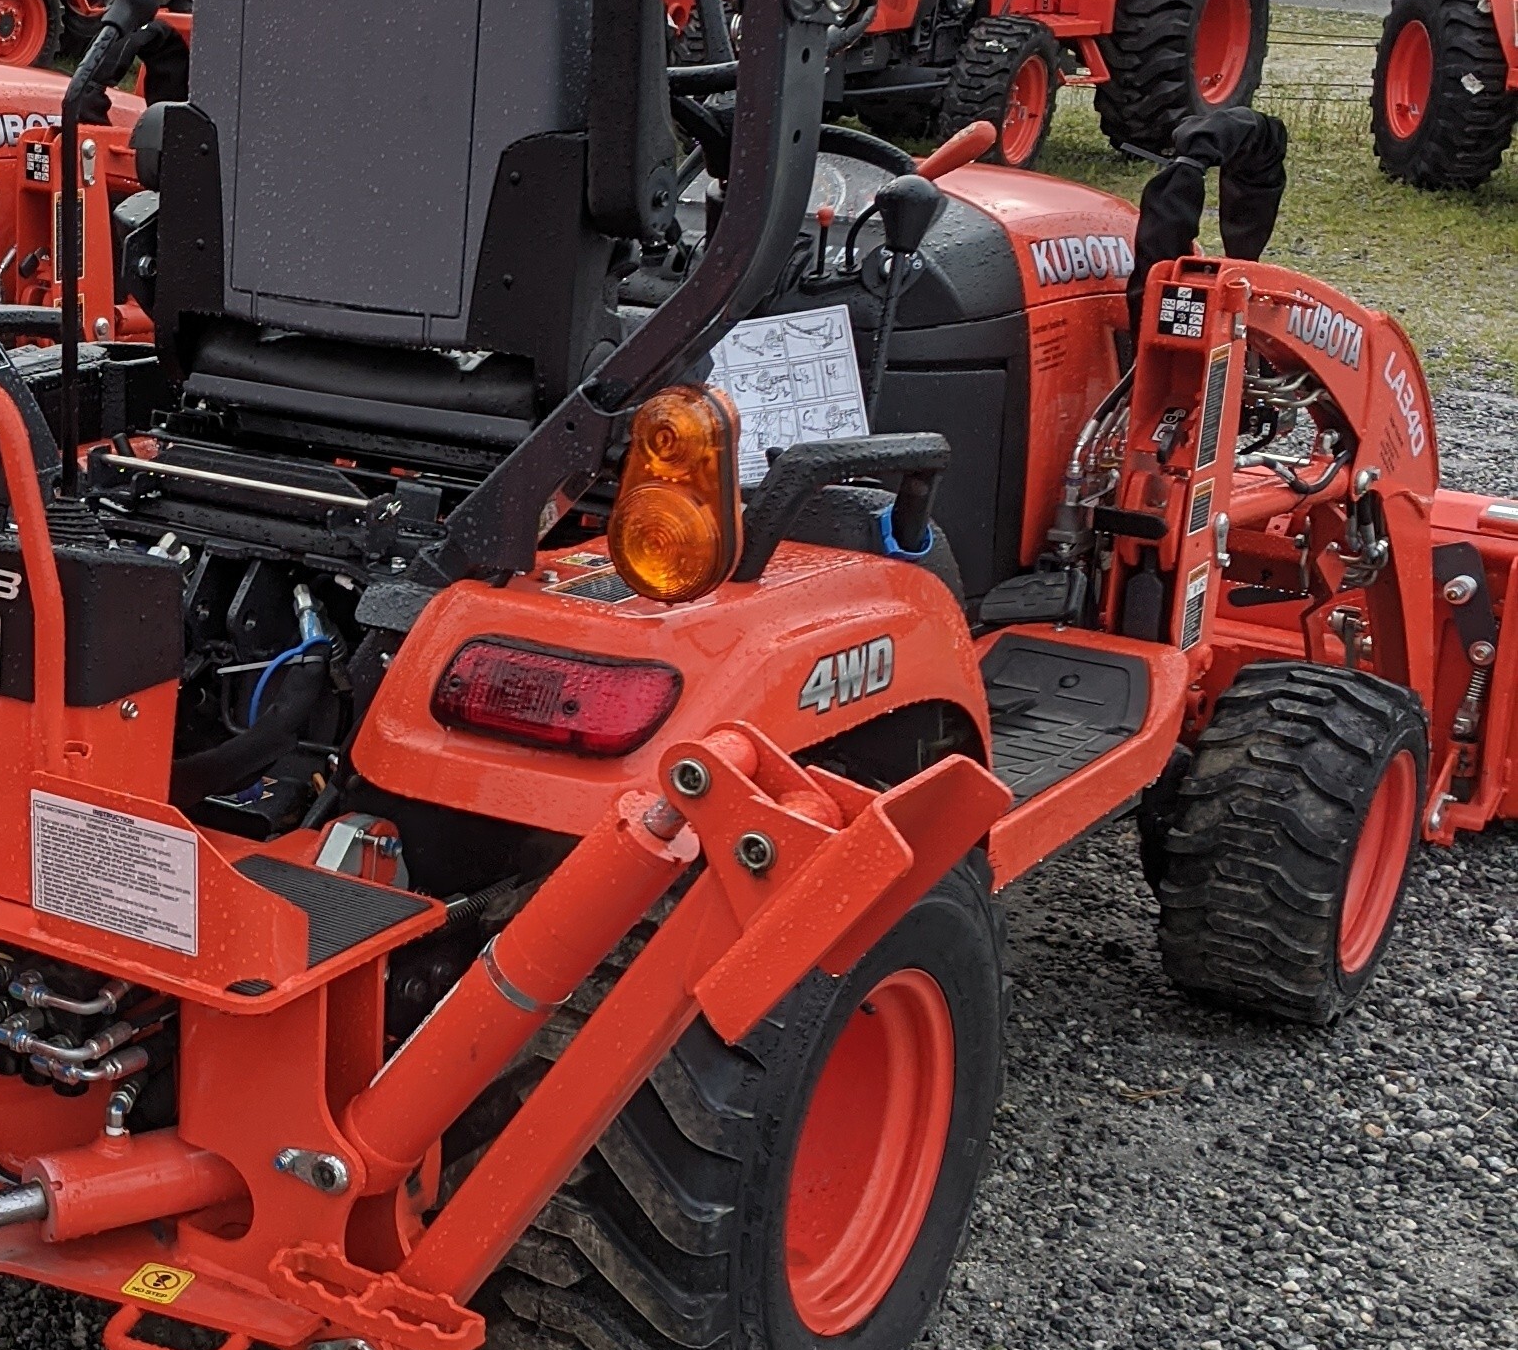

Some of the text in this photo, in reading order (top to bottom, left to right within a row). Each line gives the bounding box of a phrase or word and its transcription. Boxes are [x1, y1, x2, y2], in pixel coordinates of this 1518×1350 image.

[1029, 235, 1136, 287] KUBOTA
[1287, 289, 1364, 371] KUBOTA
[1384, 351, 1425, 457] LA340
[799, 633, 895, 715] 4WD
[145, 1289, 168, 1298] STEP
